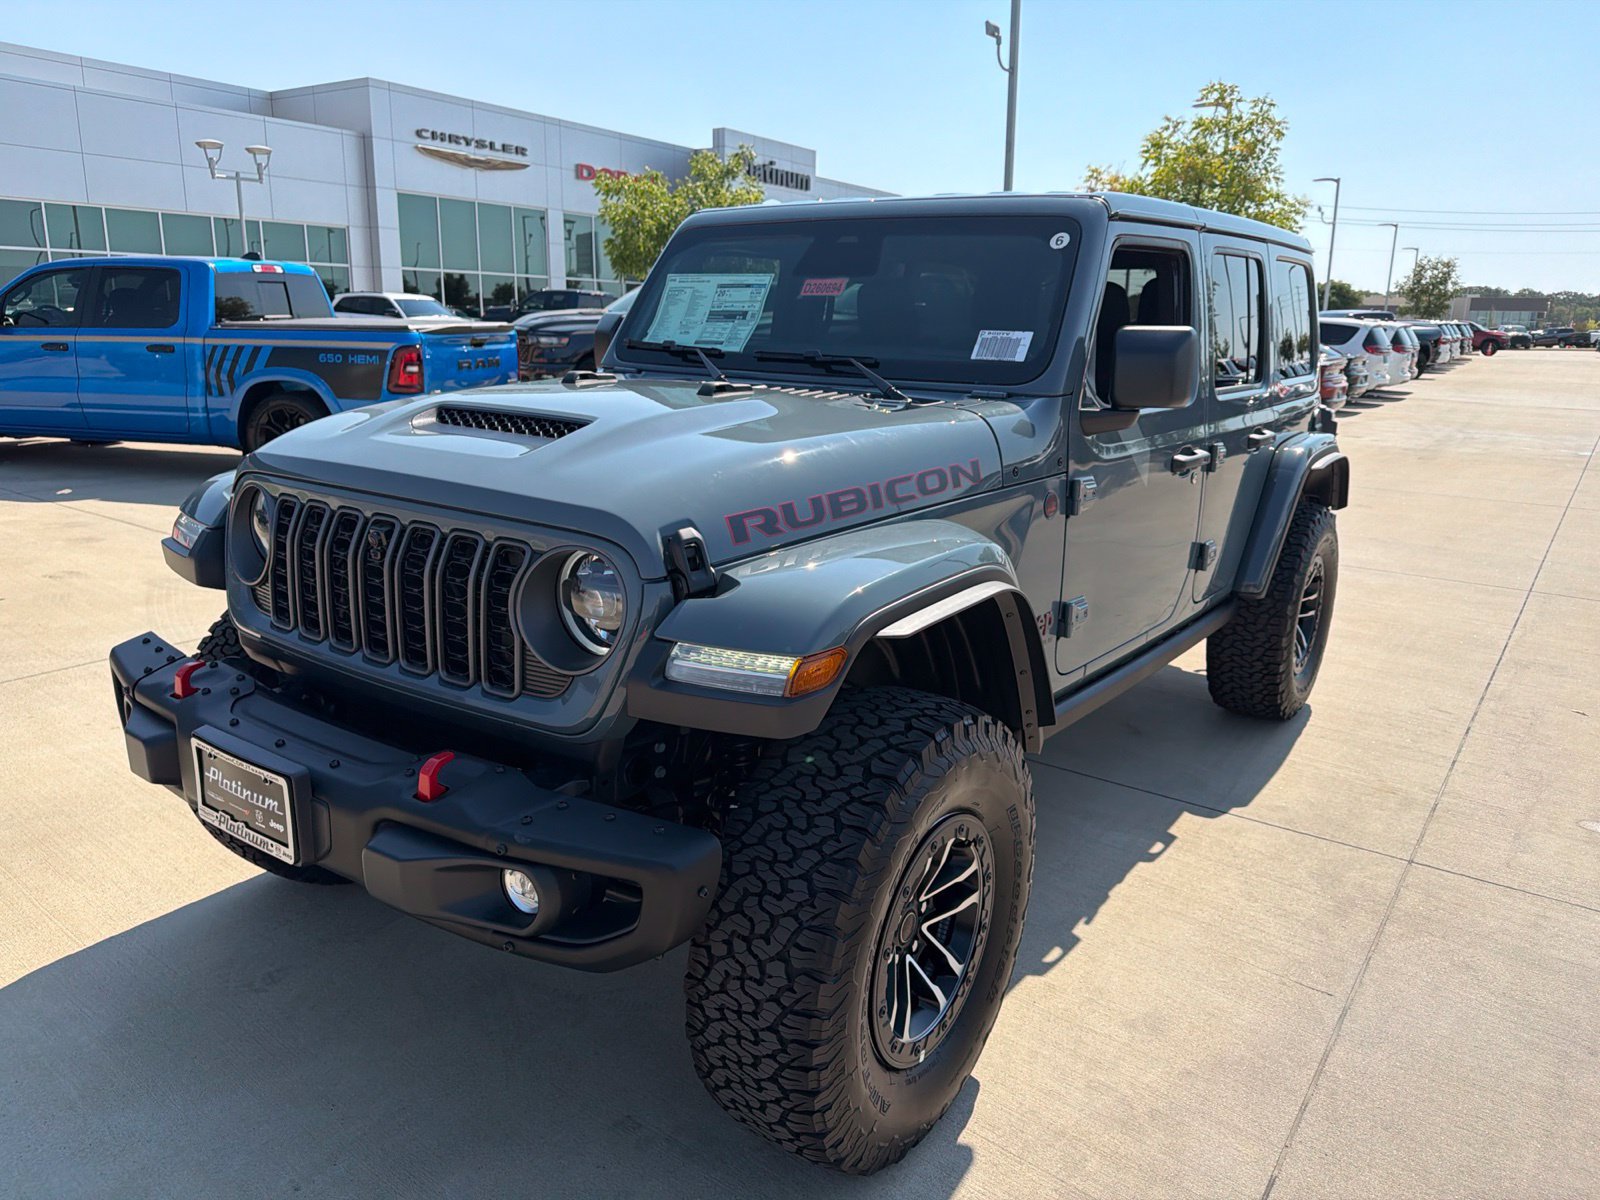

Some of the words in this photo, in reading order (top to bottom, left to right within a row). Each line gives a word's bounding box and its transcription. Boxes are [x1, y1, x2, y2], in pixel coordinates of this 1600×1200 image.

[415, 128, 528, 156] CHRYSLER
[1055, 235, 1064, 246] 6
[318, 353, 342, 363] 650
[348, 354, 379, 364] HEMI
[458, 357, 500, 370] RAM
[724, 459, 983, 546] RUBICON
[205, 766, 284, 816] Platinum
[218, 813, 275, 854] Platinum
[268, 819, 285, 833] Jeep
